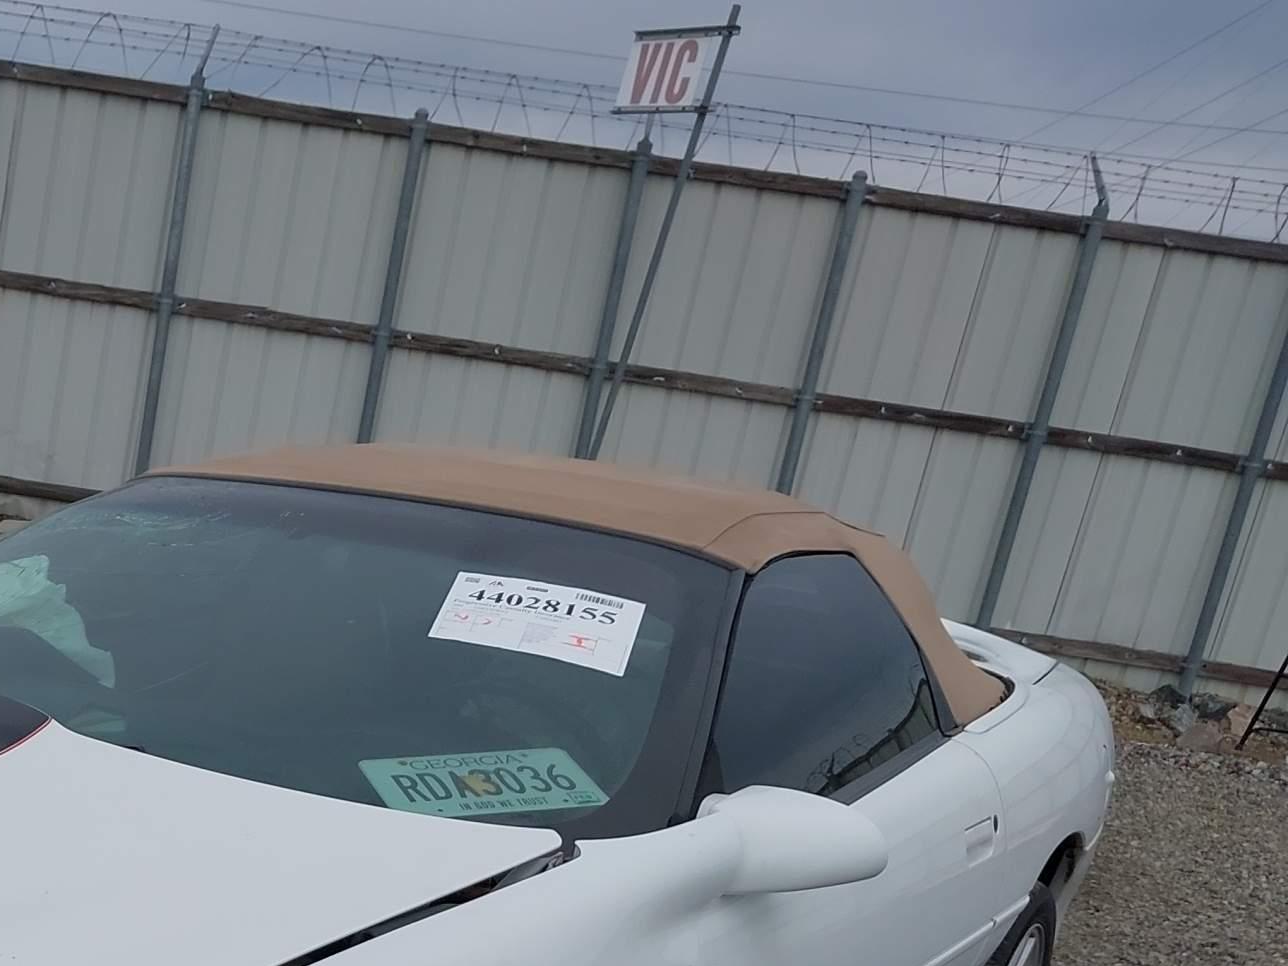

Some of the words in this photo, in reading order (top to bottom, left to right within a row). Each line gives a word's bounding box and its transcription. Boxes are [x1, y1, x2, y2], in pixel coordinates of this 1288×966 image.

[629, 39, 699, 105] VIC
[467, 589, 618, 626] 44028155
[408, 752, 524, 771] GEORGIA
[391, 763, 578, 803] RDA3036
